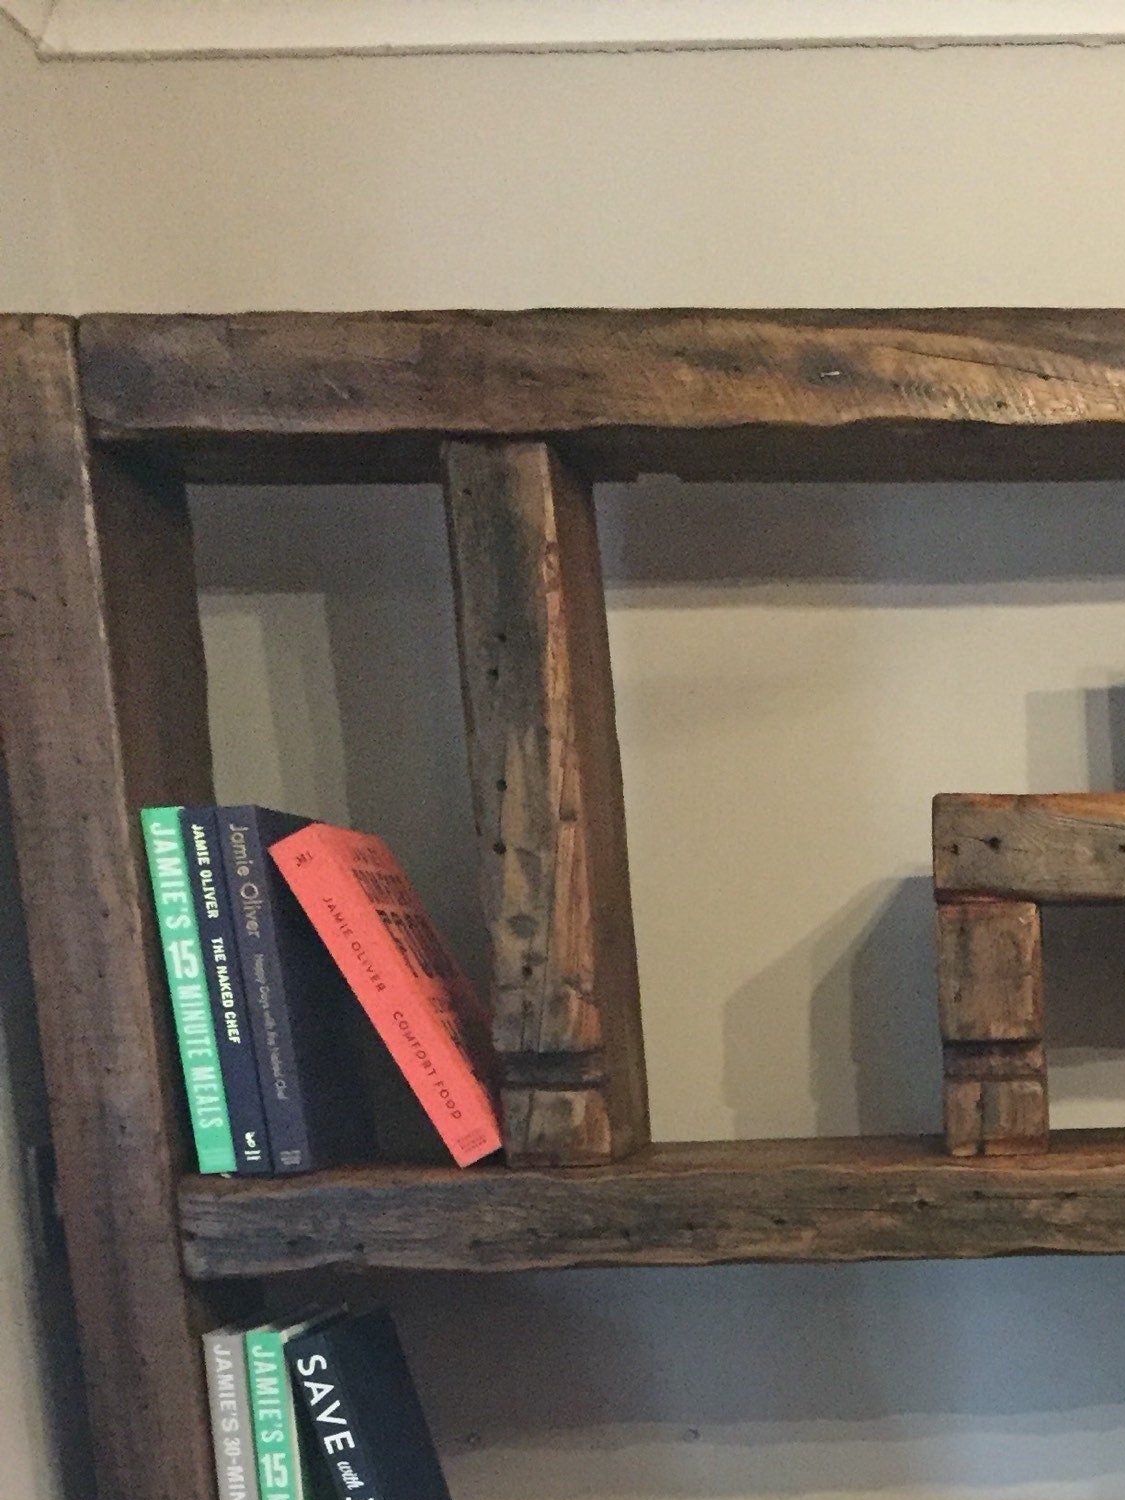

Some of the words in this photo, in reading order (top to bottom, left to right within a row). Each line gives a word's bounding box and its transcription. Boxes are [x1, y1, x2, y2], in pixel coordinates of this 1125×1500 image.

[150, 822, 191, 930] JAMIE'S
[191, 824, 212, 867] JAMIE
[200, 870, 219, 919] OLIVER
[229, 823, 250, 877] Jamie
[240, 882, 260, 938] Oliver
[169, 940, 199, 979] 15
[211, 937, 225, 959] THE
[322, 896, 352, 940] JAMIE
[351, 938, 386, 993] OLIVER
[215, 962, 234, 1012] NAKED
[176, 984, 202, 1059] MINUTE
[223, 1013, 241, 1045] CHEF
[191, 1066, 222, 1128] MEALS
[393, 1011, 437, 1079] COMFORT
[434, 1081, 463, 1120] FOOD
[213, 1344, 238, 1436] JAMIE'S
[252, 1345, 285, 1444] JAMIE'S
[298, 1353, 355, 1456] SAVE
[336, 1458, 364, 1493] with
[261, 1453, 288, 1489] 15
